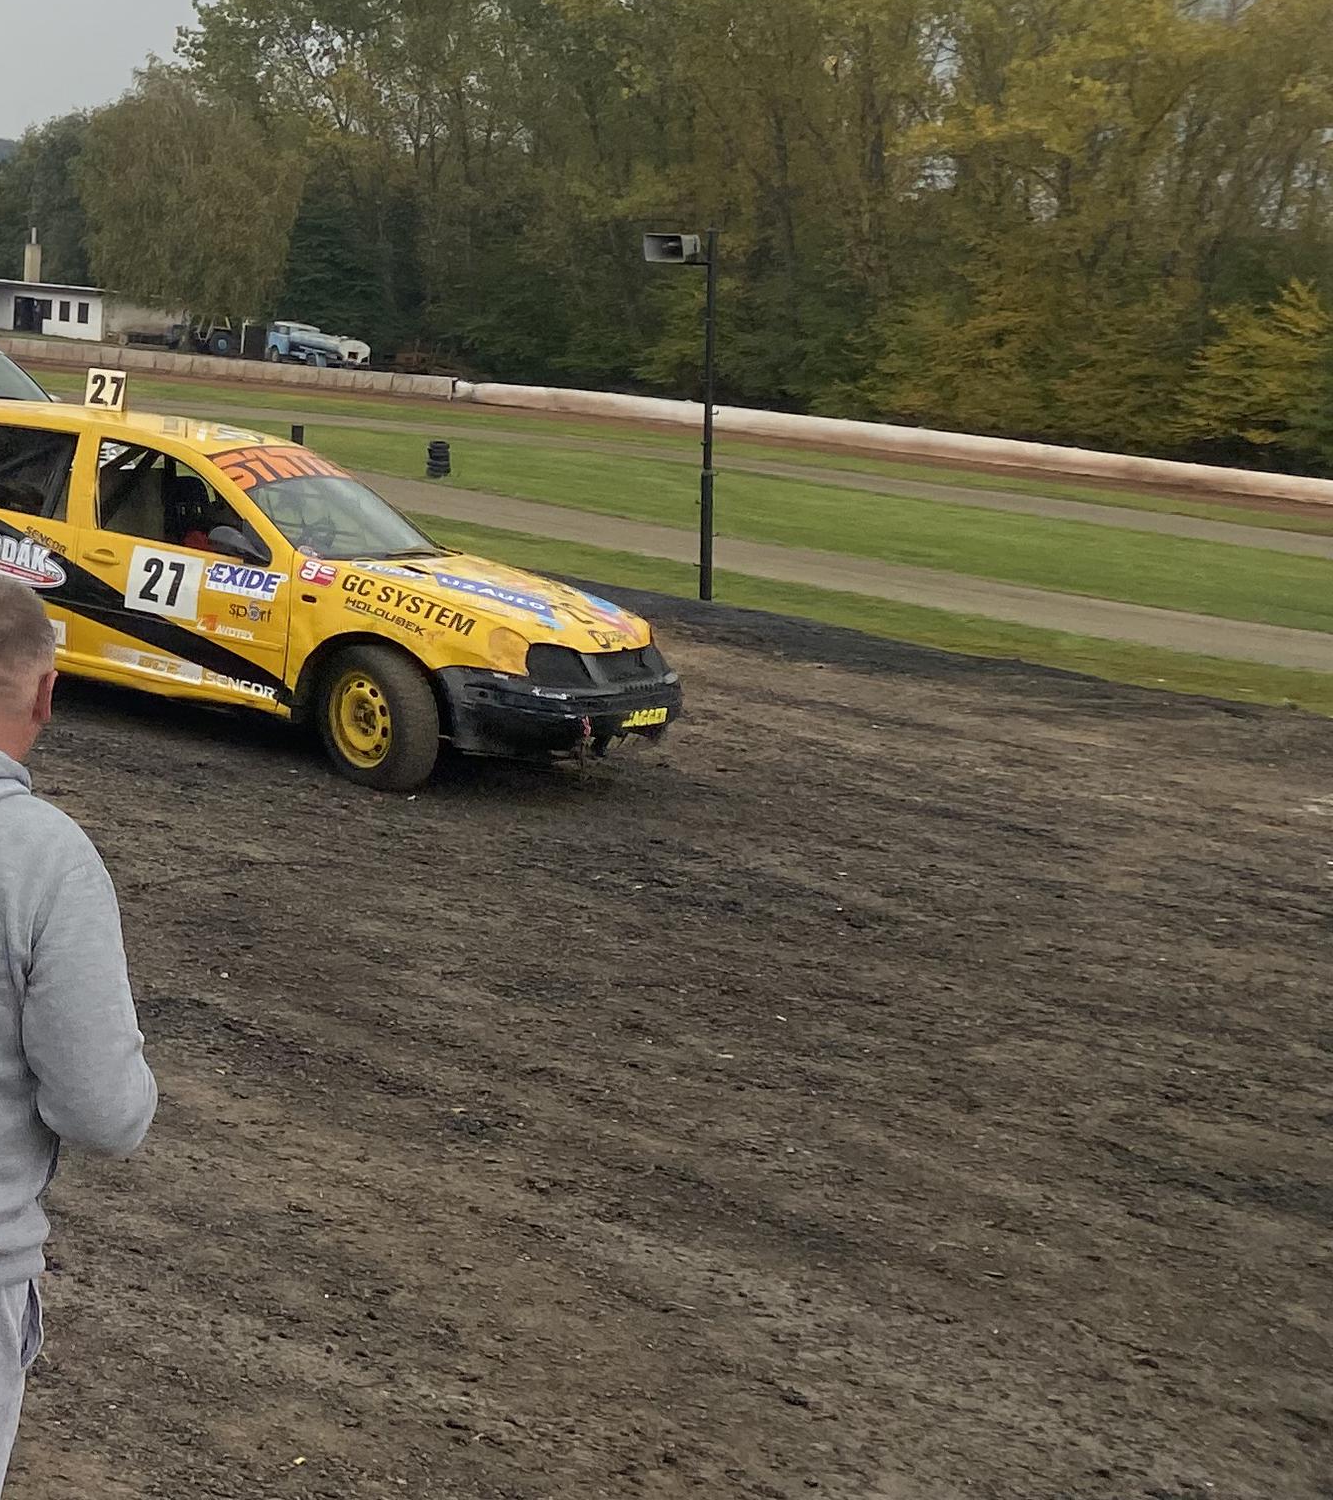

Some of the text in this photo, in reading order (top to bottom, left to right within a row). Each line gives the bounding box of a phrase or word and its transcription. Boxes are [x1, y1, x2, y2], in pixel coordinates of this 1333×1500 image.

[89, 374, 124, 405] 27
[25, 526, 67, 555] SENCOR
[138, 557, 186, 607] 27
[206, 564, 281, 593] EXIDE
[342, 574, 477, 636] GC SYSTEM
[345, 596, 429, 637] HOLOUBEK
[203, 670, 278, 700] SENCOR
